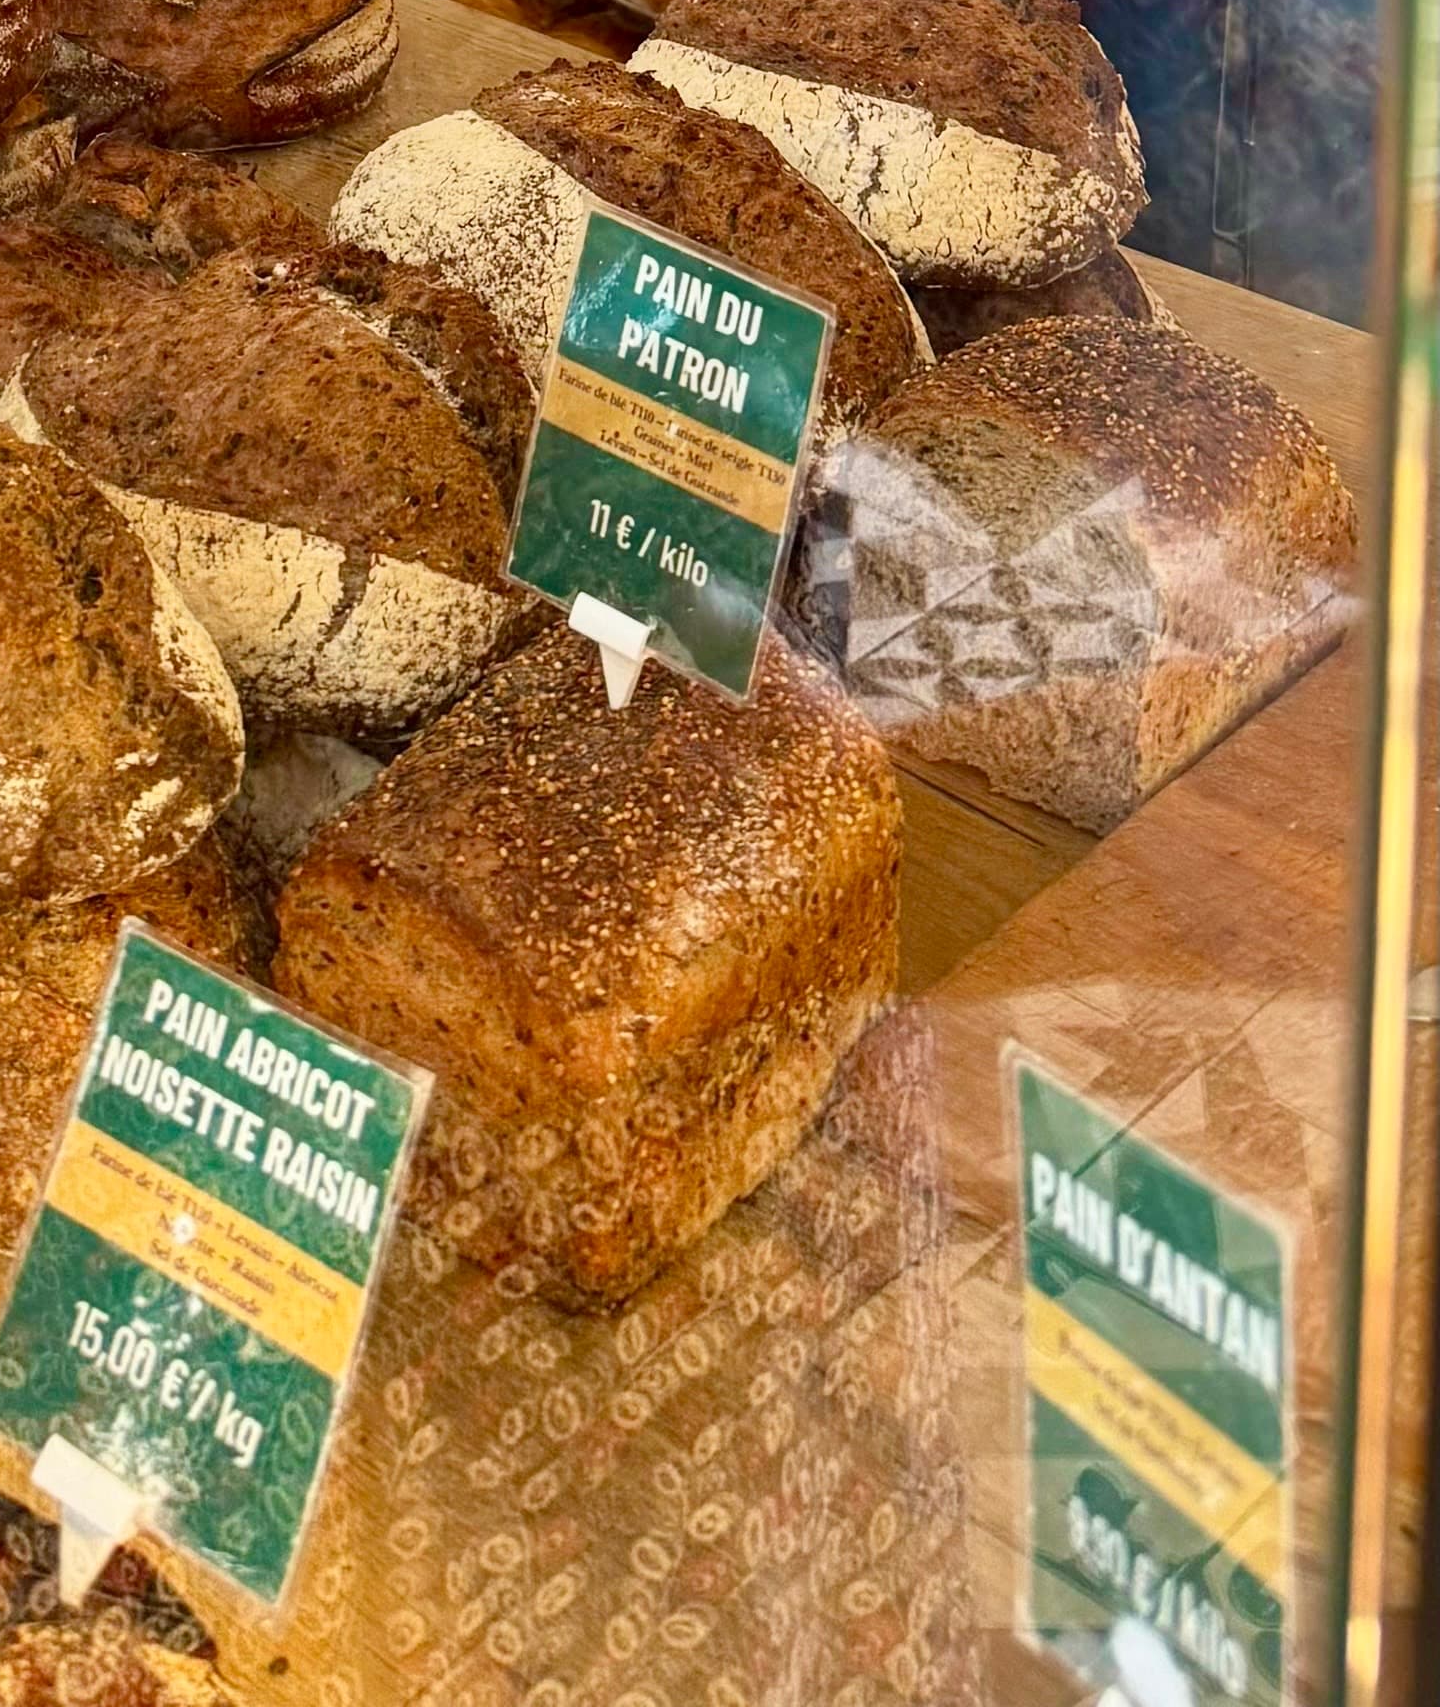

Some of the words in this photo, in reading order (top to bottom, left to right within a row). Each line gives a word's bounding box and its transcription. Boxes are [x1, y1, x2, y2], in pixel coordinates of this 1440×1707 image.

[634, 254, 713, 328] PAIN
[716, 288, 766, 347] DU
[617, 317, 751, 415] PATRON
[558, 366, 592, 394] Farine
[593, 384, 608, 402] de
[609, 392, 629, 413] blé
[665, 418, 704, 448] Frine
[704, 437, 720, 456] de
[721, 443, 755, 474] seigle
[600, 429, 637, 458] Levain
[647, 451, 666, 471] Sel
[667, 463, 682, 480] de
[684, 467, 741, 506] Guérande
[633, 425, 677, 456] Graines
[686, 450, 714, 472] Miel
[589, 498, 614, 537] 11
[615, 511, 636, 554] €
[637, 528, 658, 560] /
[659, 533, 710, 589] kilo
[140, 976, 225, 1062] PAIN
[225, 1026, 377, 1142] ABRICOT
[97, 1033, 258, 1165] NOISETTE
[261, 1129, 381, 1235] RAISIN
[1028, 1150, 1115, 1267] PAIN
[1116, 1211, 1282, 1397] D'ANTAN
[66, 1299, 155, 1391] 15,00
[160, 1359, 189, 1412] €
[217, 1385, 264, 1470] kg
